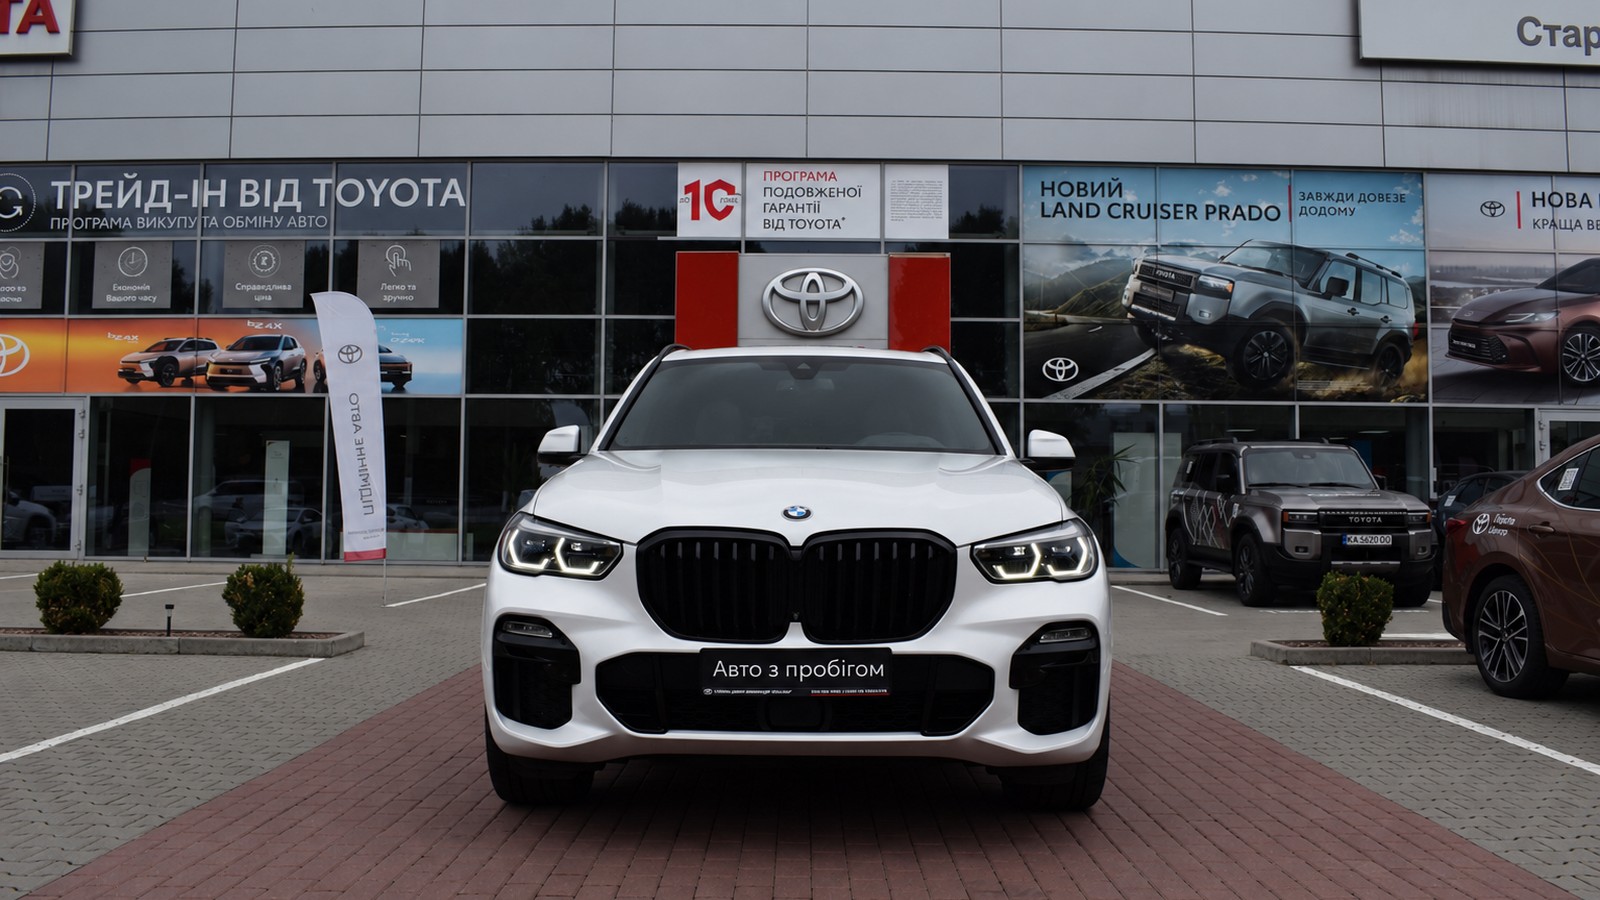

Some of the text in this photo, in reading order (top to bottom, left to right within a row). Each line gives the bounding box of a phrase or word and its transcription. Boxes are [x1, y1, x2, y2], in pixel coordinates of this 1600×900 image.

[763, 171, 838, 182] ПРОГРАМА
[51, 173, 466, 213] ТРЕЙД-ІН ВІД TOYOTA
[763, 185, 862, 199] ПОДОВЖЕНОЇ
[1041, 177, 1123, 198] НОВИЙ
[1299, 191, 1406, 204] ЗАВЖДИ ДОВЕЗЕ
[1532, 191, 1593, 208] НОВА
[763, 201, 821, 213] ГАРАНТІЇ
[1041, 202, 1281, 222] LAND CRUISER PRADO
[1299, 206, 1356, 217] ДОДОМУ
[51, 215, 328, 230] ПРОГРАМА ВИКУПУ ТА ОБМІНУ АВТО
[763, 219, 785, 231] ВІД
[1533, 219, 1582, 232] КРАЩА
[713, 659, 885, 682] Авто з пробігом
